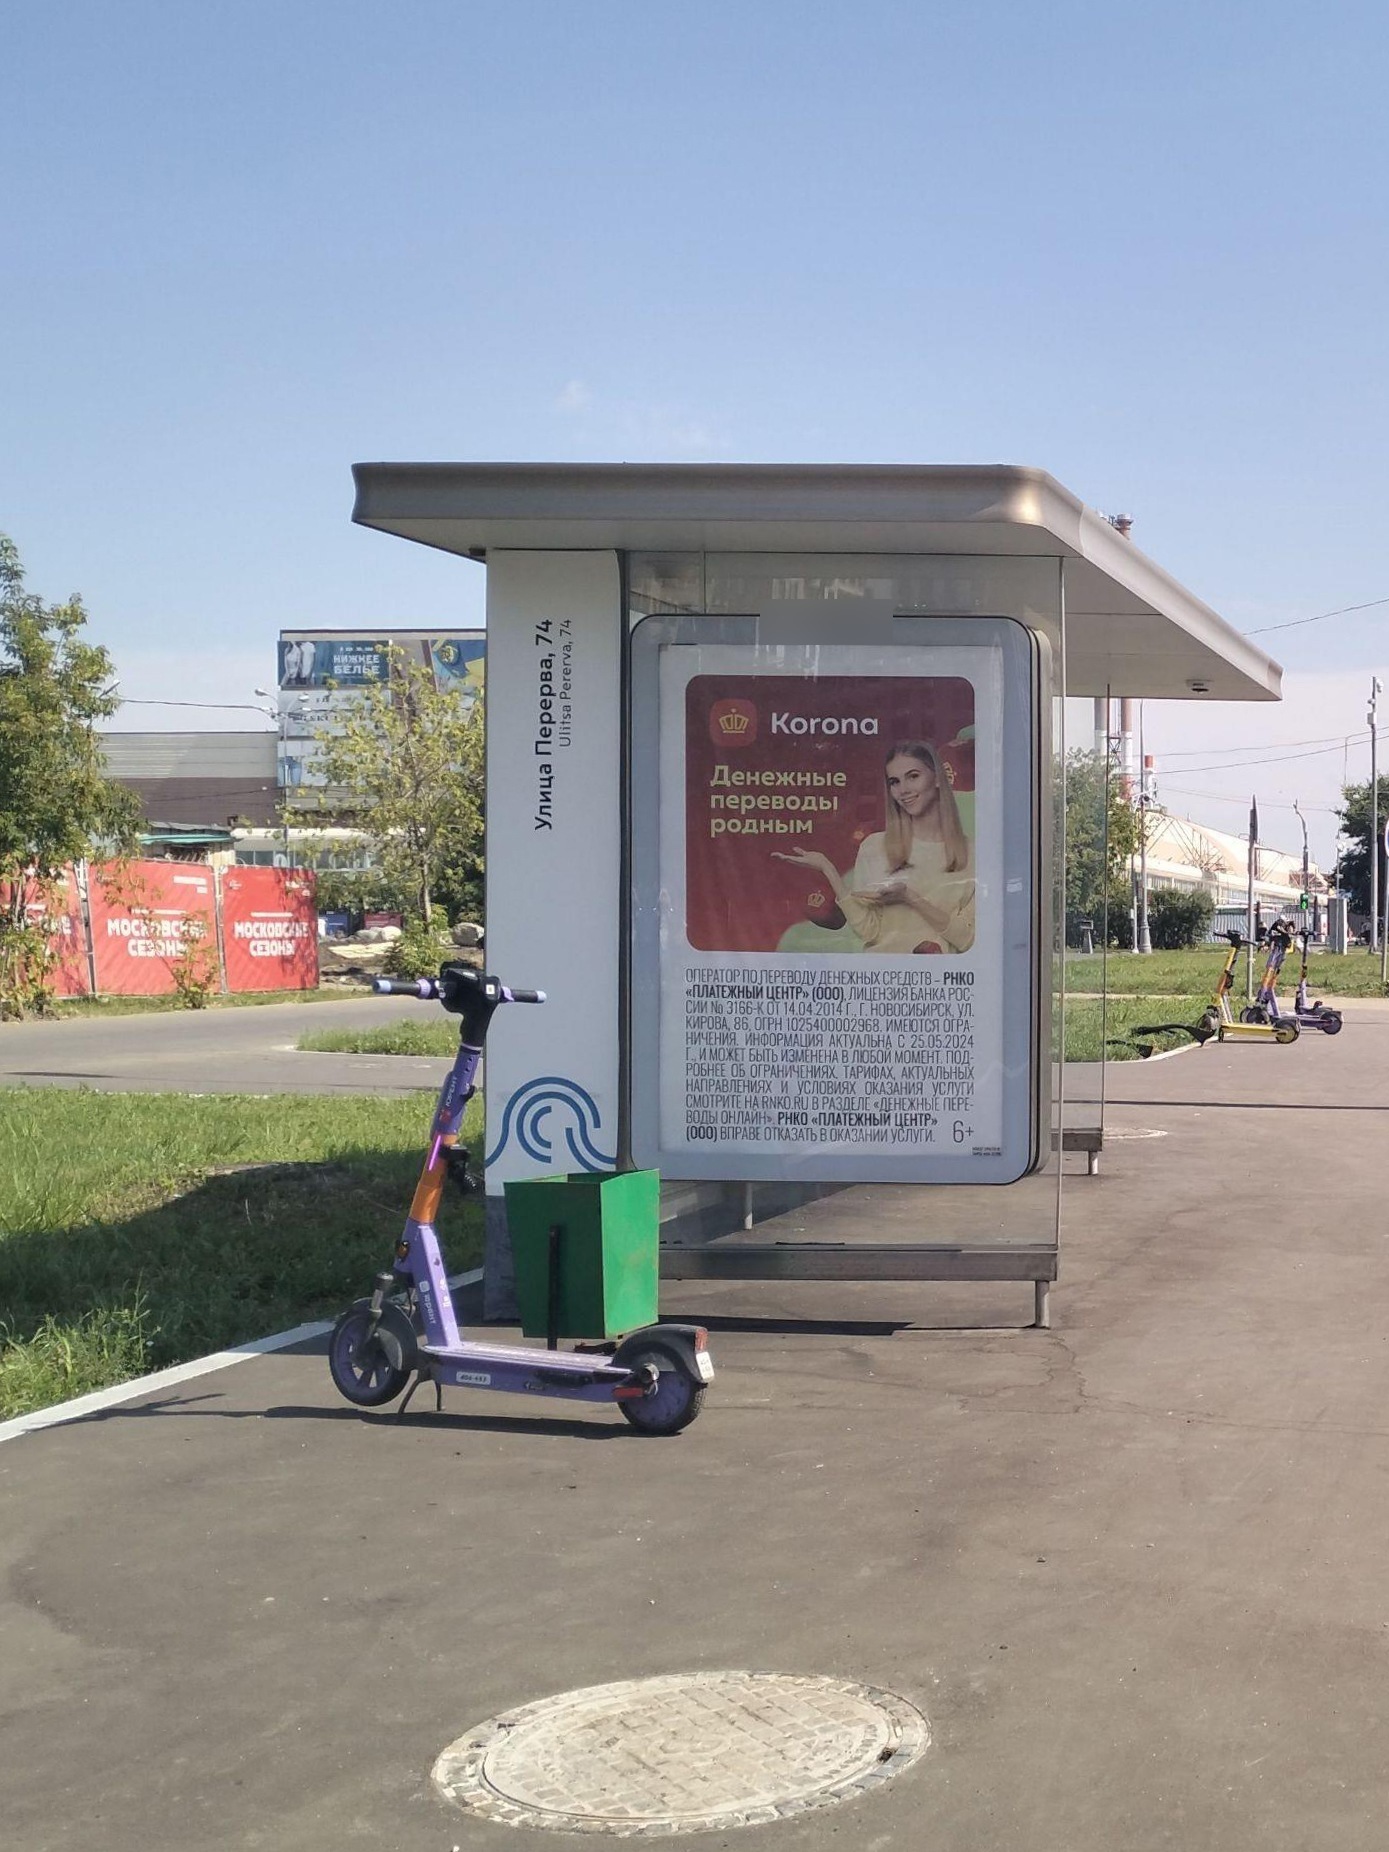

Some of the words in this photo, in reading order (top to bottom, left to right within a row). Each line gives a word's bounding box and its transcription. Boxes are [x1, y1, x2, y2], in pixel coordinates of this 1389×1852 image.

[535, 619, 553, 646] 74
[560, 619, 571, 636] 74
[333, 655, 379, 663] НИЖНЕЕ
[334, 665, 379, 674] БЕЛЬЕ
[560, 641, 573, 699] Pererva,
[535, 653, 556, 755] Перерва,
[559, 705, 571, 747] Ulitsa
[771, 712, 879, 735] Korona
[710, 764, 847, 787] Денежные
[534, 763, 555, 831] Улица
[711, 793, 838, 814] переводы
[711, 818, 812, 838] родным
[685, 969, 740, 983] ОПЕРАТОР
[742, 969, 758, 983] ПО
[759, 970, 816, 985] ПЕРЕВОДУ
[819, 971, 880, 985] ДЕНЕЖНЫХ
[883, 971, 932, 987] СРЕДСТВ
[944, 972, 974, 985] РНКО
[685, 984, 763, 999] «ПЛАТЕЖНЫЙ
[766, 986, 809, 1000] ЦЕНТР»
[849, 987, 909, 1002] ЛИЦЕНЗИЯ
[911, 988, 945, 1001] БАНКА
[949, 988, 974, 1001] РОС-
[685, 1000, 708, 1014] СИИ
[711, 1001, 723, 1014] №
[727, 1001, 764, 1014] 3166-К
[767, 1002, 781, 1015] ОТ
[784, 1002, 842, 1016] 14.04.2014
[871, 1003, 954, 1017] НОВОСИБИРСК,
[958, 1003, 974, 1018] УЛ.
[686, 1016, 731, 1031] КИРОВА,
[754, 1018, 782, 1031] ОГРН
[786, 1018, 882, 1032] 1025400002968.
[886, 1019, 939, 1032] ИМЕЮТСЯ
[943, 1019, 974, 1032] ОГРА-
[686, 1032, 738, 1046] НИЧЕНИЯ.
[745, 1033, 824, 1047] ИНФОРМАЦИЯ
[829, 1034, 892, 1049] АКТУАЛЬНА
[898, 1035, 905, 1048] С
[911, 1035, 974, 1048] 25.05.2024
[699, 1048, 706, 1061] И
[710, 1048, 746, 1061] МОЖЕТ
[749, 1049, 778, 1062] БЫТЬ
[781, 1049, 838, 1064] ИЗМЕНЕНА
[842, 1050, 848, 1063] В
[852, 1049, 891, 1064] ЛЮБОЙ
[895, 1051, 942, 1064] МОМЕНТ.
[946, 1051, 974, 1066] ПОД-
[686, 1063, 725, 1077] РОБНЕЕ
[731, 1064, 745, 1077] ОБ
[843, 1066, 895, 1080] ТАРИФАХ,
[901, 1066, 974, 1081] АКТУАЛЬНЫХ
[686, 1079, 772, 1093] НАПРАВЛЕНИЯХ
[781, 1081, 788, 1094] И
[798, 1081, 856, 1095] УСЛОВИЯХ
[865, 1081, 923, 1095] ОКАЗАНИЯ
[933, 1082, 974, 1097] УСЛУГИ
[686, 1094, 741, 1108] СМОТРИТЕ
[745, 1096, 759, 1109] НА
[762, 1096, 809, 1110] RNKO.RU
[812, 1097, 819, 1110] В
[822, 1097, 870, 1112] РАЗДЕЛЕ
[874, 1097, 940, 1112] «ДЕНЕЖНЫЕ
[943, 1097, 974, 1111] ПЕРЕ-
[686, 1110, 718, 1124] ВОДЫ
[778, 1112, 808, 1125] РНКО
[811, 1112, 891, 1126] «ПЛАТЕЖНЫЙ
[895, 1113, 938, 1128] ЦЕНТР»
[686, 1126, 718, 1142] (ООО)
[720, 1127, 761, 1140] ВПРАВЕ
[764, 1127, 817, 1141] ОТКАЗАТЬ
[820, 1128, 826, 1141] В
[830, 1129, 888, 1142] ОКАЗАНИИ
[891, 1129, 935, 1143] УСЛУГИ.
[953, 1120, 974, 1143] 6+
